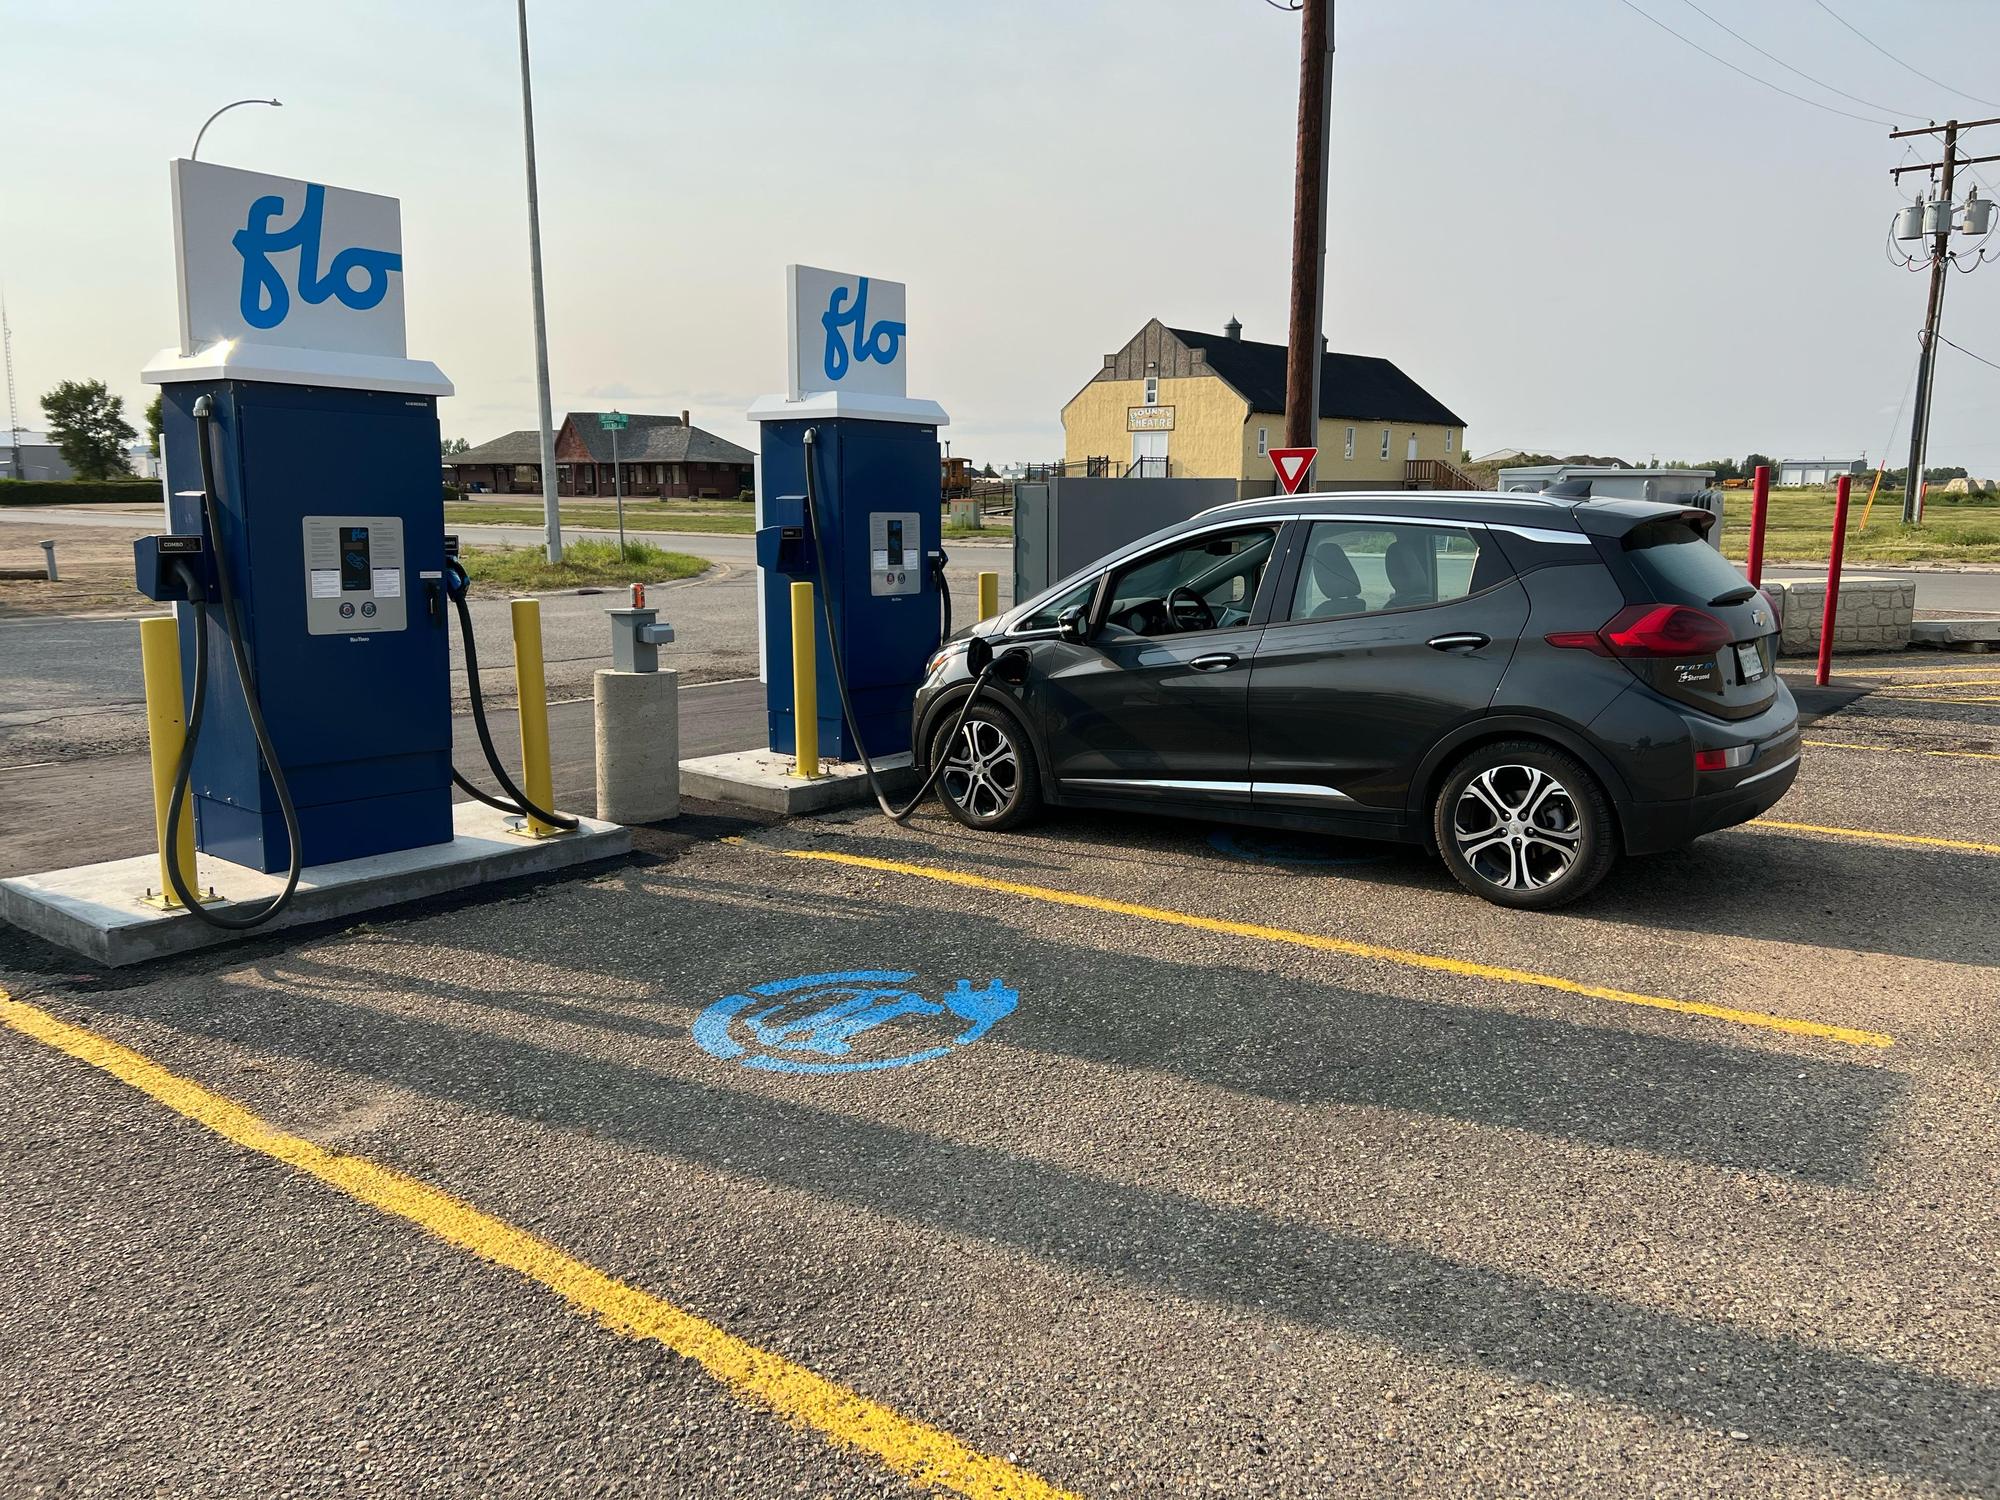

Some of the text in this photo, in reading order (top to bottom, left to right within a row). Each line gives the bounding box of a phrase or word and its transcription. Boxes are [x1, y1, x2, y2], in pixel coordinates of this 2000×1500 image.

[232, 184, 403, 330] flo
[821, 277, 906, 381] flo
[1130, 418, 1172, 428] THEATRE
